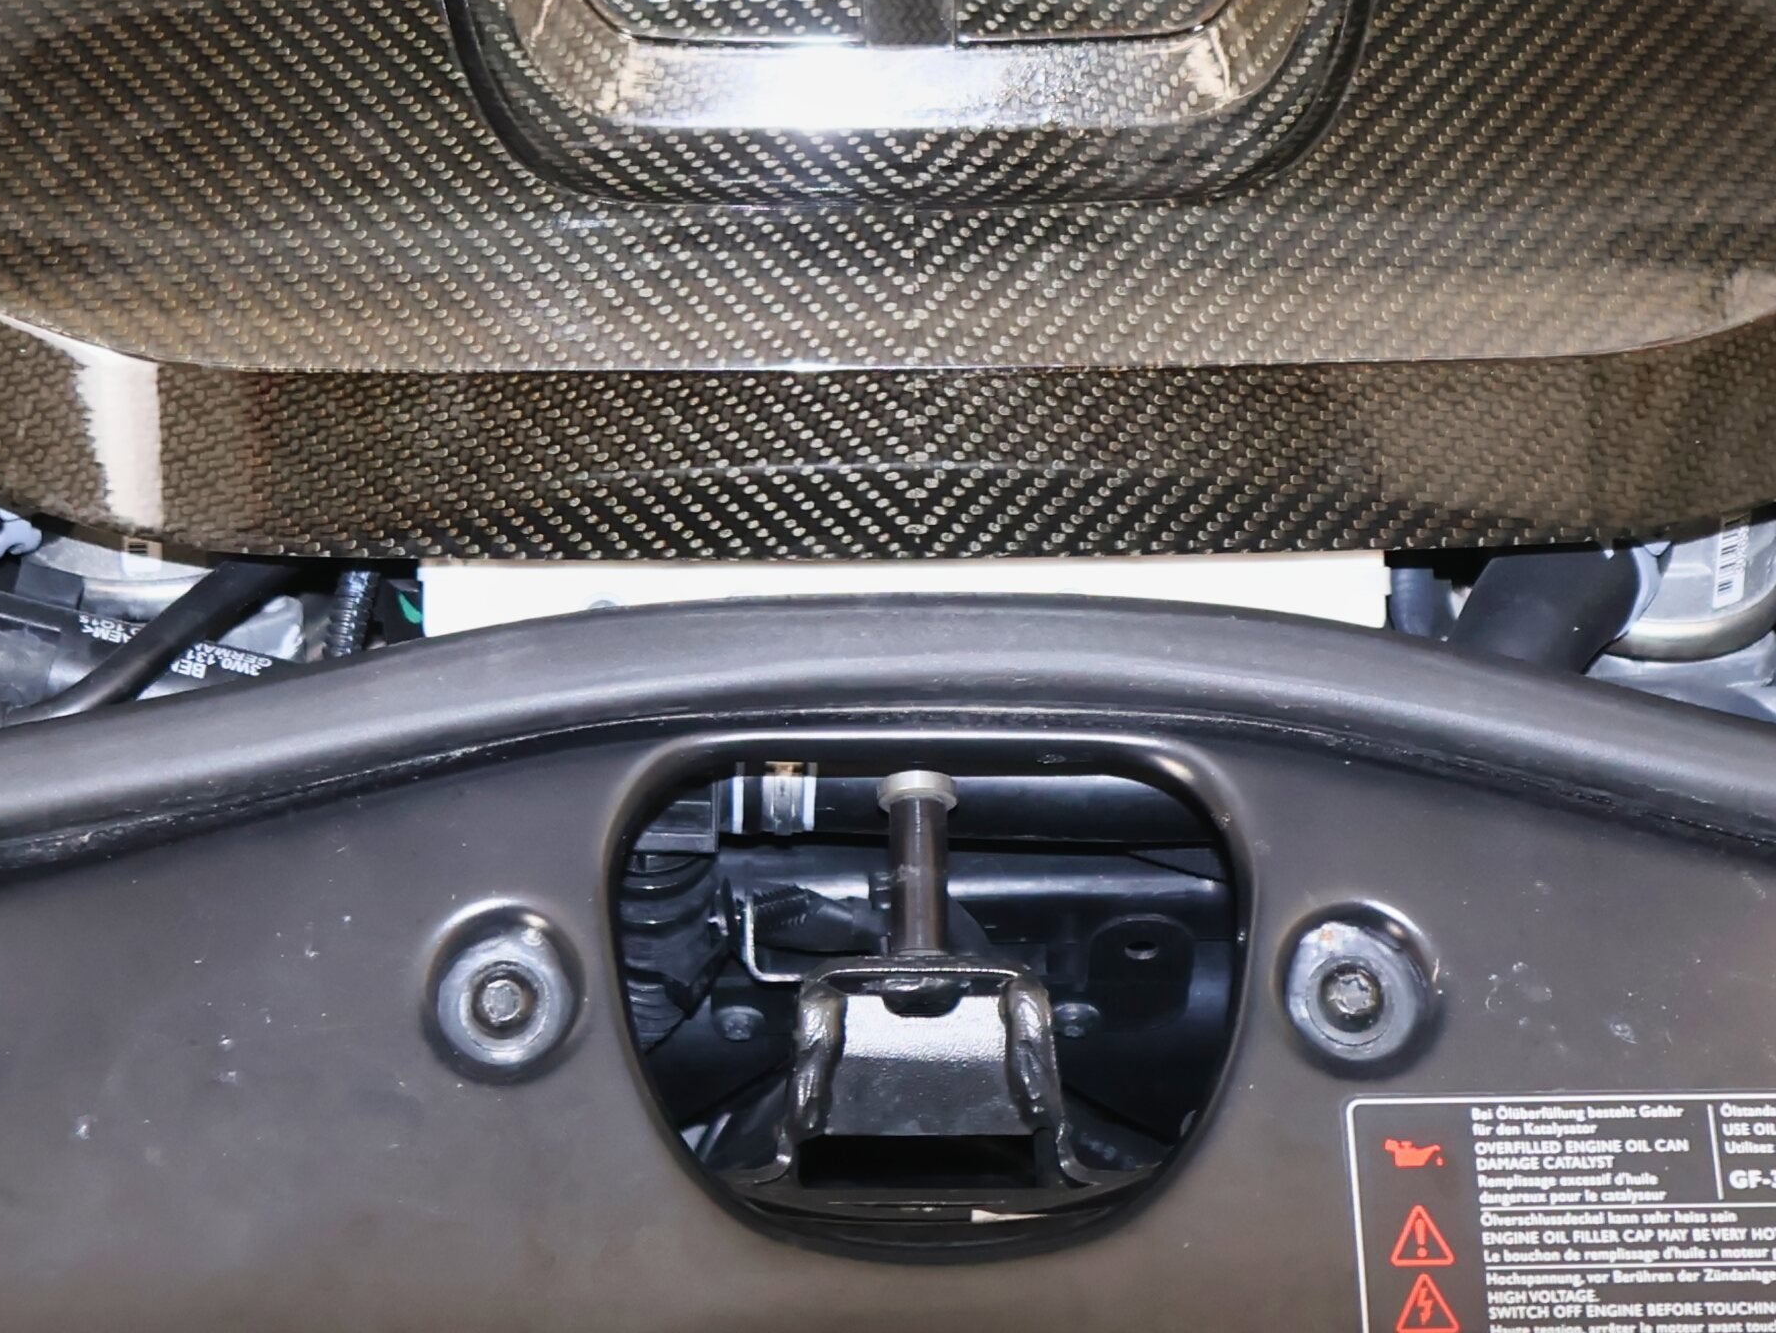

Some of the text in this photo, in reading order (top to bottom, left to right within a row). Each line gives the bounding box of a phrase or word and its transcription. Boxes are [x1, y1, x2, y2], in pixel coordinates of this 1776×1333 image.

[1495, 1123, 1521, 1136] den
[1722, 1123, 1751, 1136] USE
[1474, 1138, 1690, 1155] OVERFILLED ENGINE OIL CAN
[1724, 1140, 1775, 1155] Utilisez
[1475, 1155, 1615, 1171] DAMAGE CATALYST
[1549, 1192, 1582, 1205] pour
[1584, 1189, 1599, 1203] le
[1607, 1211, 1639, 1224] kann
[1710, 1210, 1738, 1223] sein
[1482, 1231, 1540, 1245] ENGINE
[1542, 1231, 1571, 1244] OIL
[1573, 1230, 1619, 1244] FILLER
[1622, 1230, 1655, 1243] CAP
[1657, 1229, 1690, 1243] MAY
[1692, 1228, 1711, 1242] BE
[1711, 1227, 1748, 1241] VERY
[1483, 1250, 1501, 1263] Le
[1503, 1249, 1561, 1262] bouchon
[1563, 1248, 1582, 1262] de
[1721, 1246, 1770, 1259] moteur
[1586, 1273, 1611, 1284] vor
[1676, 1269, 1700, 1283] der
[1487, 1290, 1527, 1304] HIGH
[1488, 1306, 1550, 1320] SWITCH
[1552, 1305, 1584, 1319] OFF
[1586, 1304, 1644, 1318] ENGINE
[1645, 1302, 1704, 1317] BEFORE
[1708, 1322, 1743, 1333] avant
